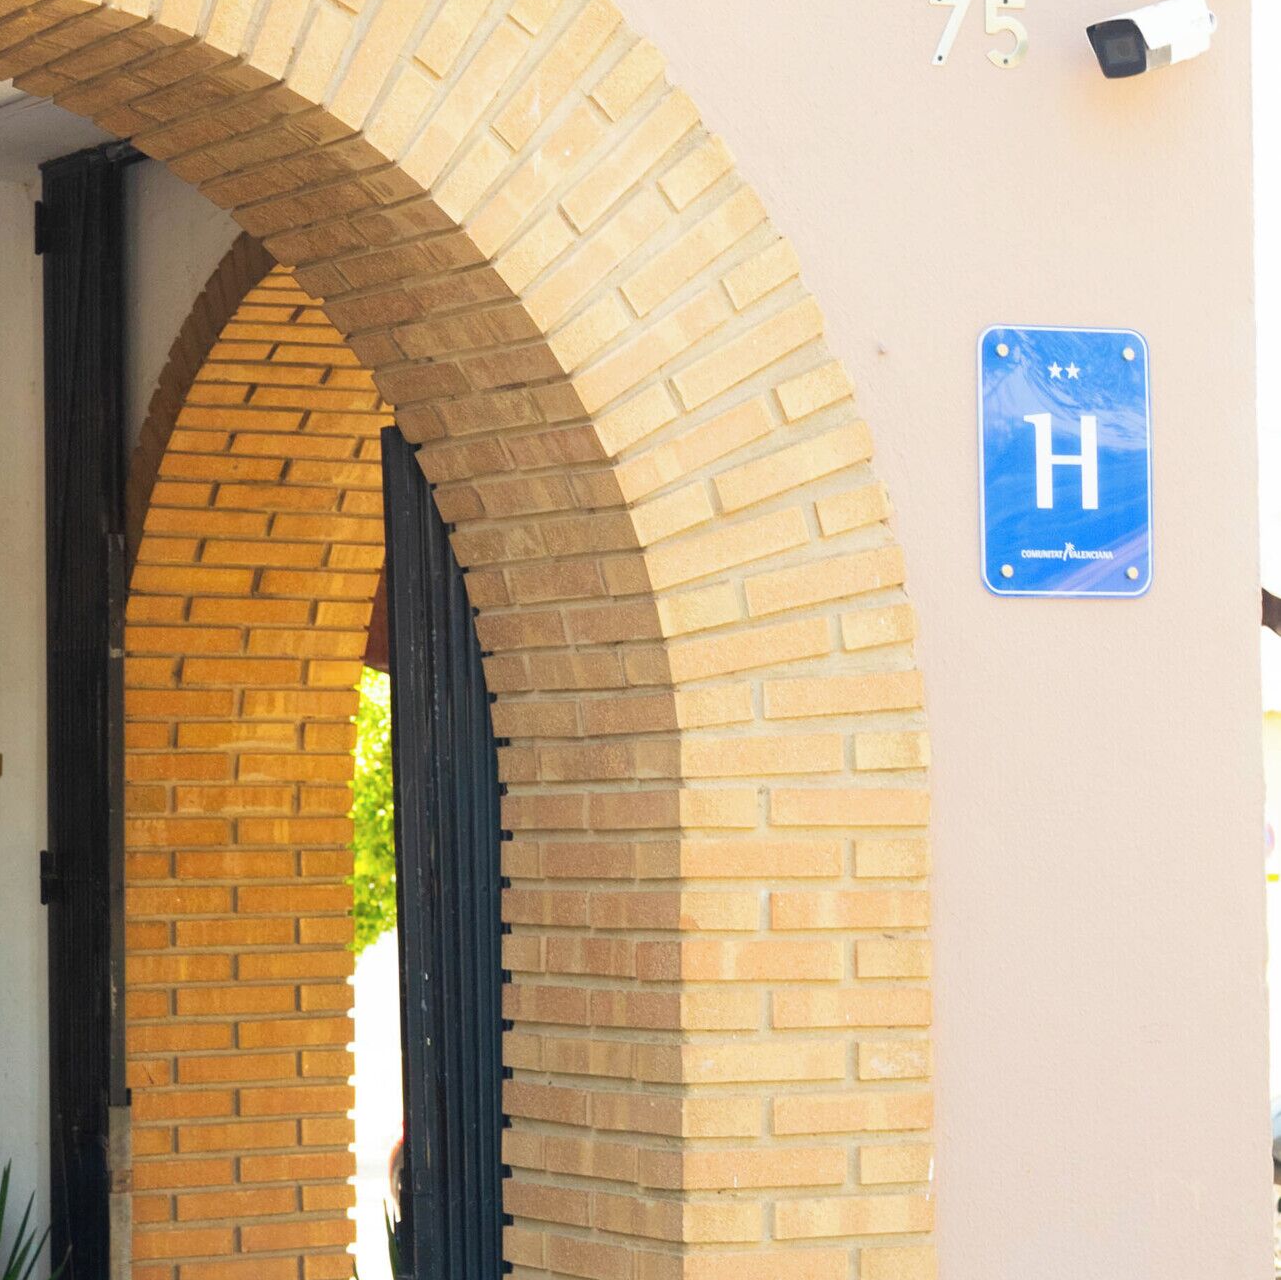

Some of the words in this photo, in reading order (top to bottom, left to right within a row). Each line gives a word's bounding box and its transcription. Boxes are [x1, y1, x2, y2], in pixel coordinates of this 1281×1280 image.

[1023, 412, 1099, 510] H
[1021, 549, 1063, 559] COMUNITAT
[1068, 549, 1114, 560] VALENCIANA
